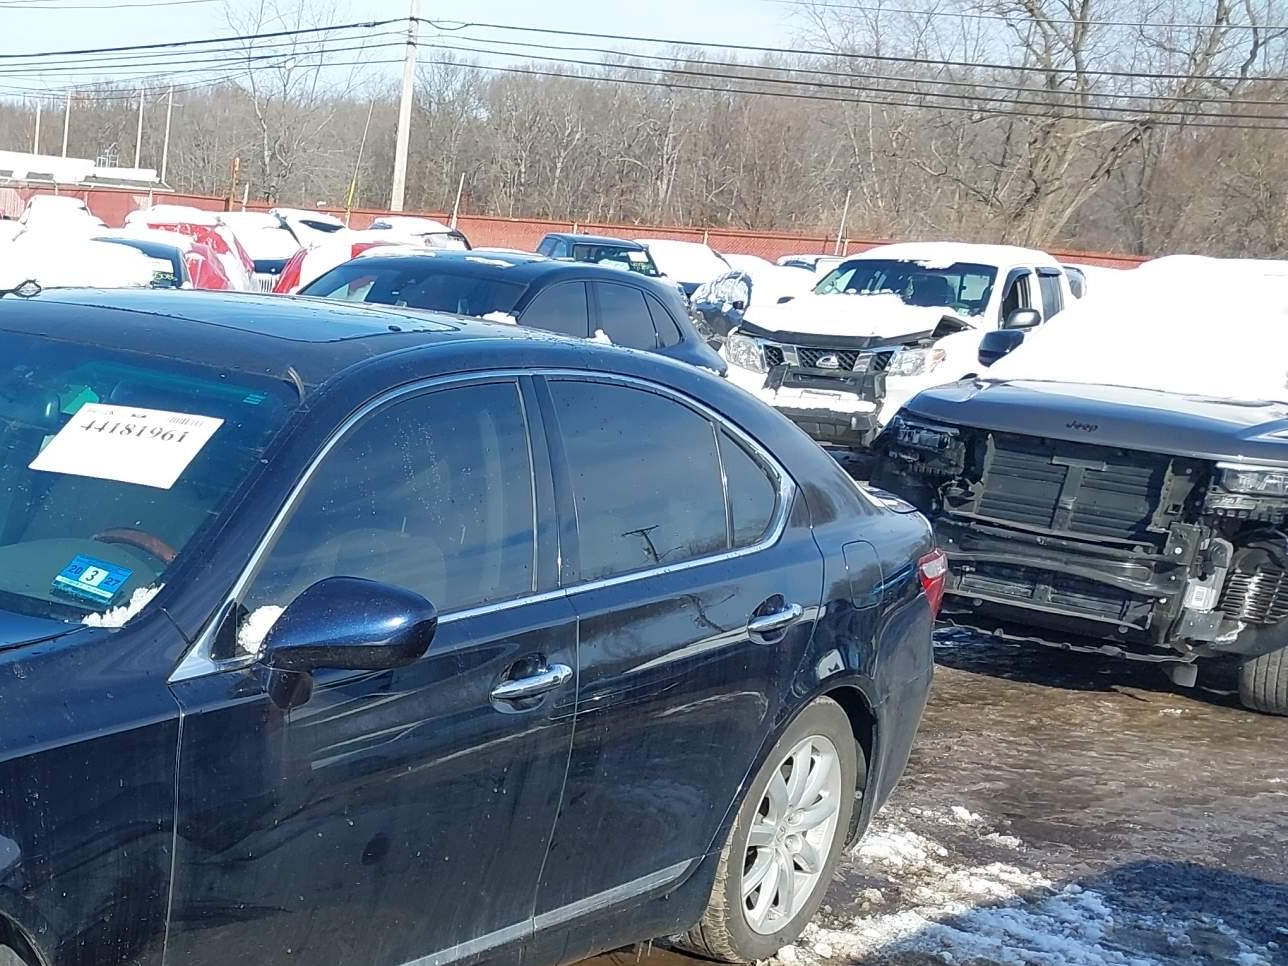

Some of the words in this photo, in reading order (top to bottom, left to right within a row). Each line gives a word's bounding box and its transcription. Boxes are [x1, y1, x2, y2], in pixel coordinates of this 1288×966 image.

[80, 420, 189, 443] 44181961
[1065, 419, 1099, 434] Jeep
[85, 570, 100, 582] 3
